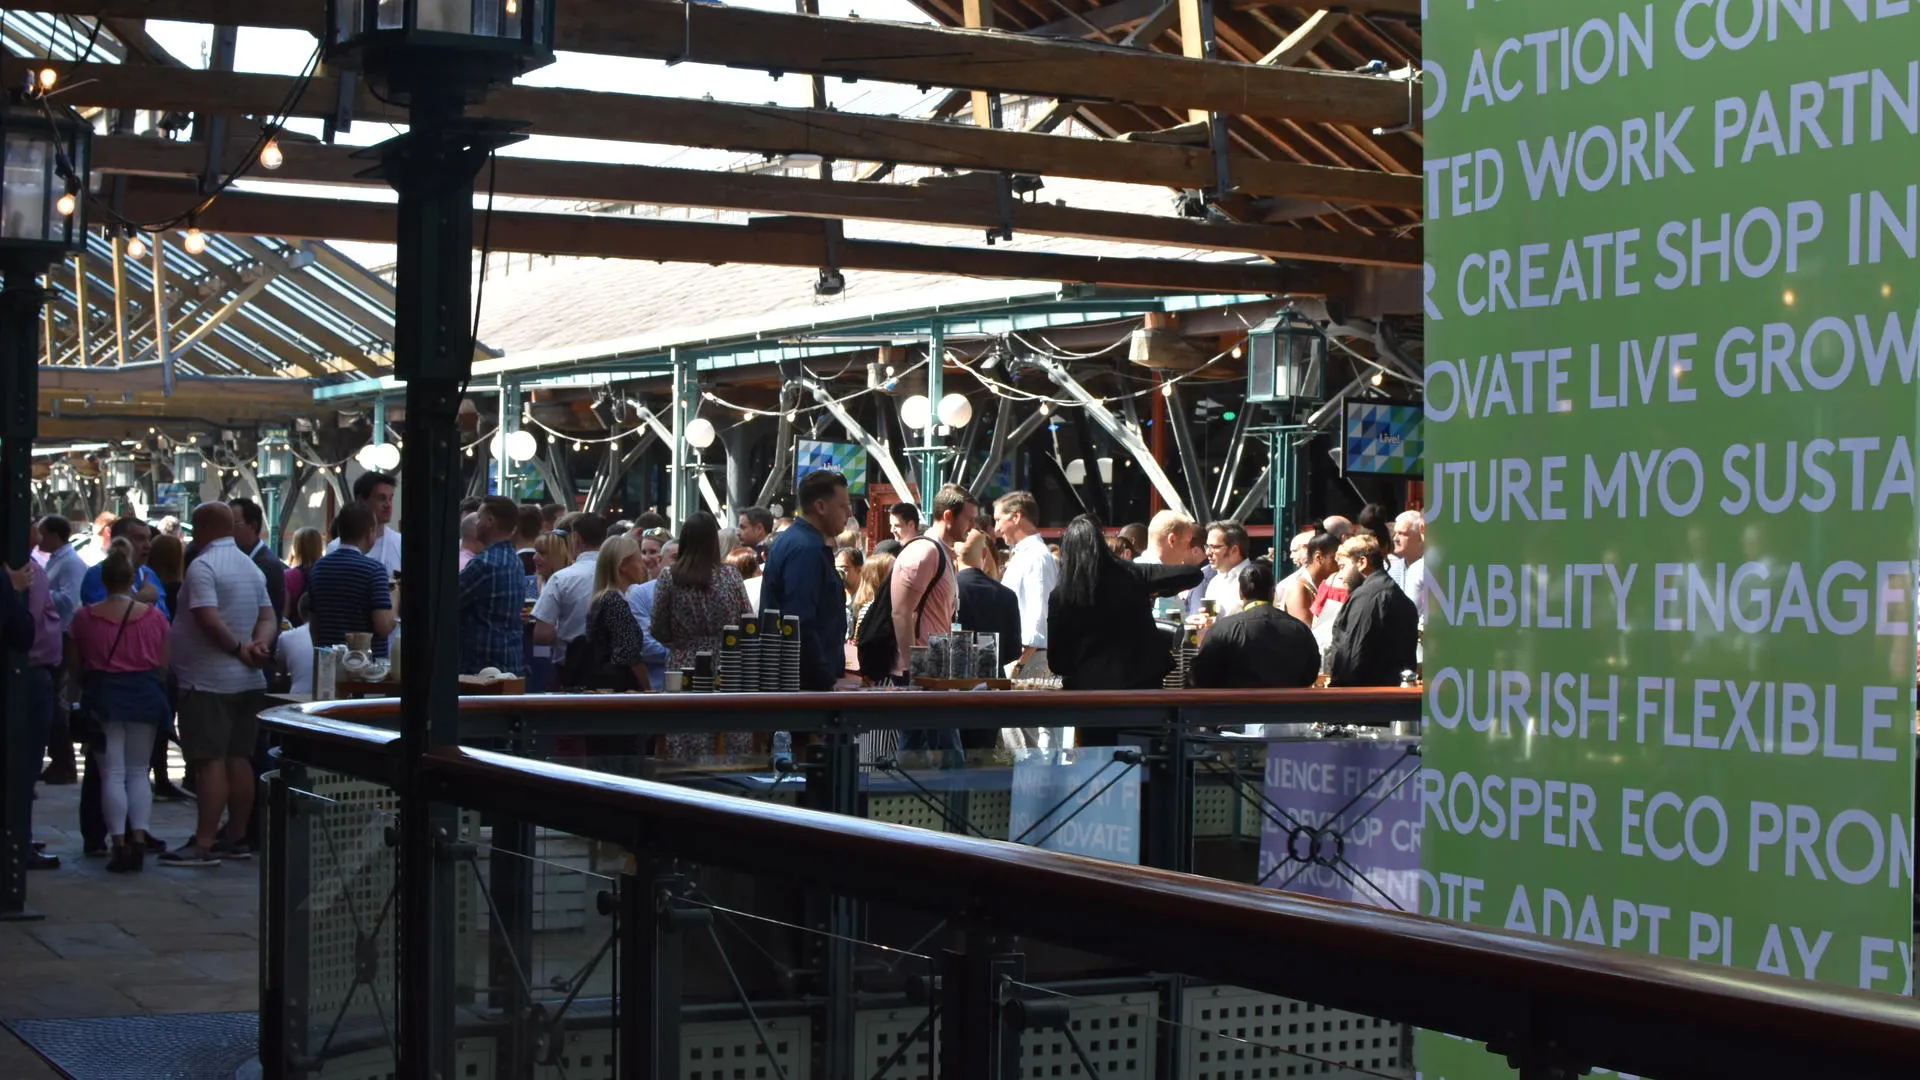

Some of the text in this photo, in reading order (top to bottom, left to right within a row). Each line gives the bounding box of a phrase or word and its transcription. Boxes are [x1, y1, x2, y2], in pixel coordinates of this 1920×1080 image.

[1461, 3, 1653, 112] ACTION
[1674, 0, 1909, 60] CON
[1423, 61, 1919, 220] TED WORK PARTN
[1457, 228, 1640, 316] CREATE
[1654, 200, 1823, 290] SHOP
[1848, 184, 1917, 265] IN
[1424, 308, 1920, 422] OVATE LIVE GROW
[1379, 433, 1400, 444] Live!
[1584, 447, 1704, 518] MYO
[1720, 435, 1914, 515] SUSTA
[1424, 560, 1909, 635] NABILITY ENGAGE
[1422, 666, 1897, 761] OURISH FLEXIBLE
[1420, 768, 1602, 851] ROSPER
[1621, 788, 1728, 866] ECO
[1259, 851, 1420, 903] ENVIRONMENT
[1503, 884, 1671, 955] ADAPT
